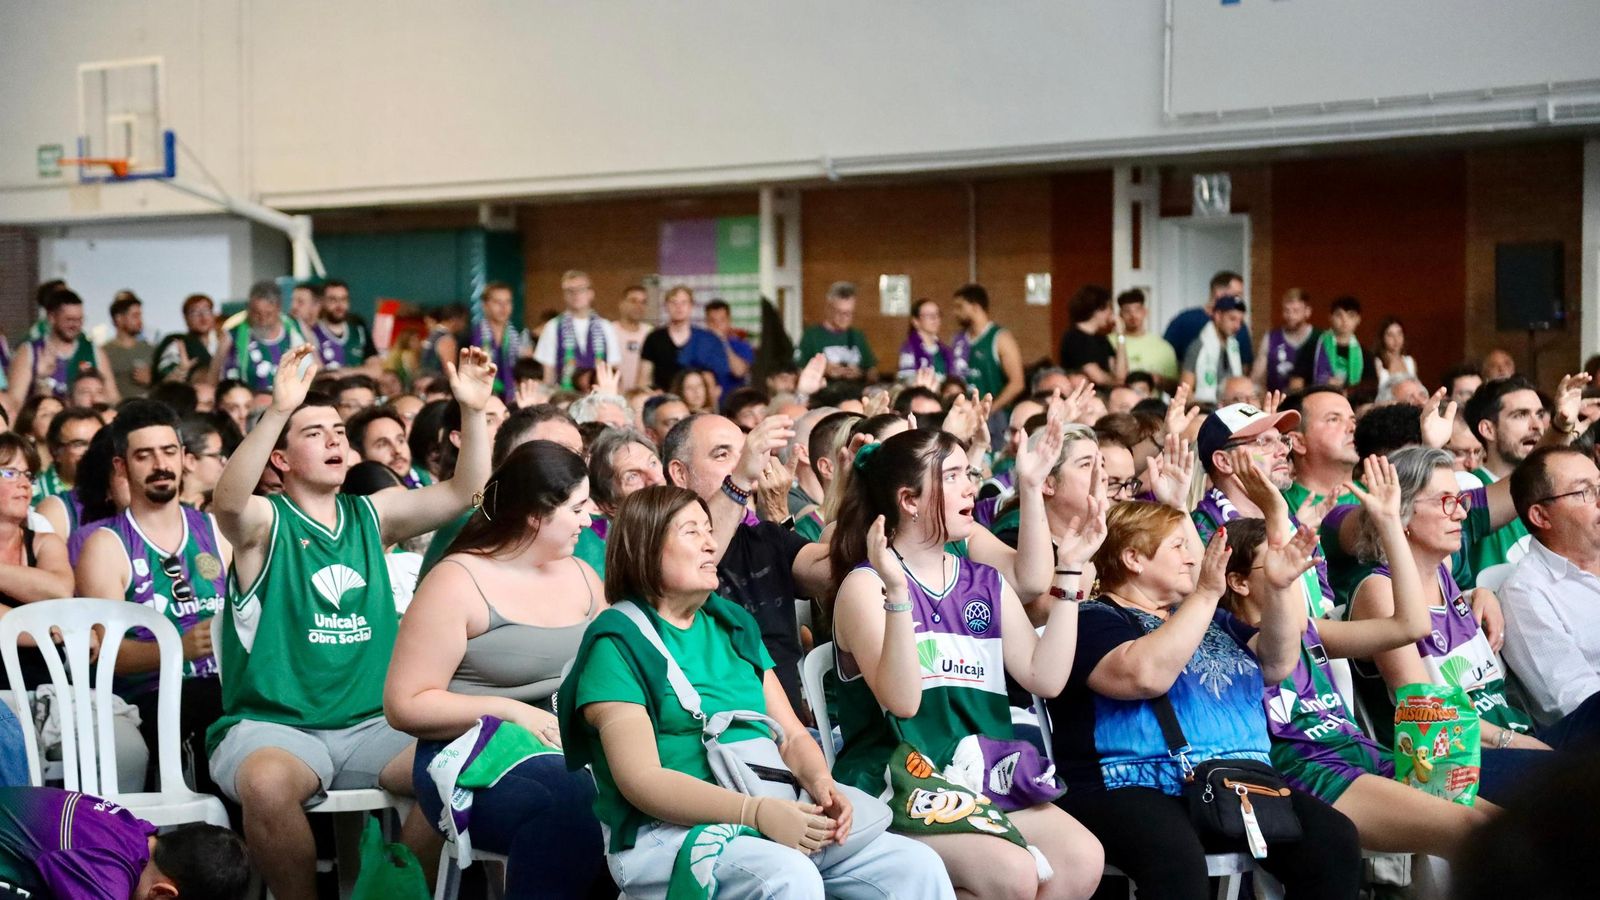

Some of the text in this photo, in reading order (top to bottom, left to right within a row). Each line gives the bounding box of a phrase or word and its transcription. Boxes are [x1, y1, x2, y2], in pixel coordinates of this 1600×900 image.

[314, 613, 367, 632] Unicaja
[308, 629, 372, 644] Obra Social
[941, 658, 985, 679] Unicaja
[1299, 692, 1342, 714] Unica
